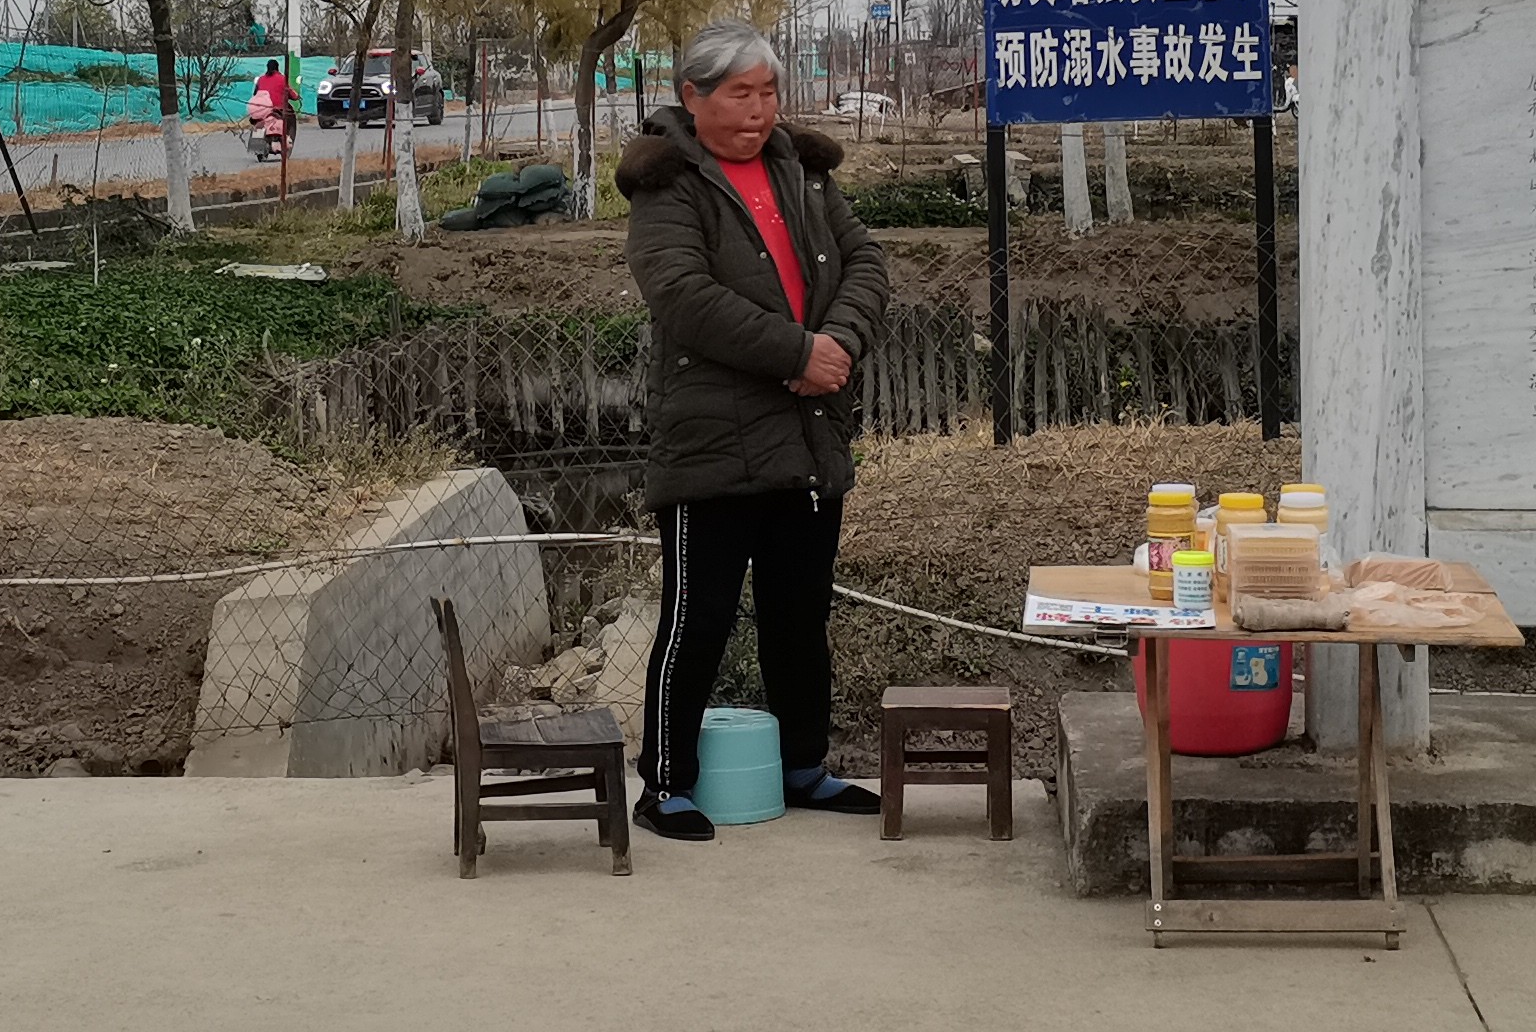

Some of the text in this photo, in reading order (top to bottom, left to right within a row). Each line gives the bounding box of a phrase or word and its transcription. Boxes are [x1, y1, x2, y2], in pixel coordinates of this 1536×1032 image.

[995, 22, 1263, 89] 预防溺水事故发生
